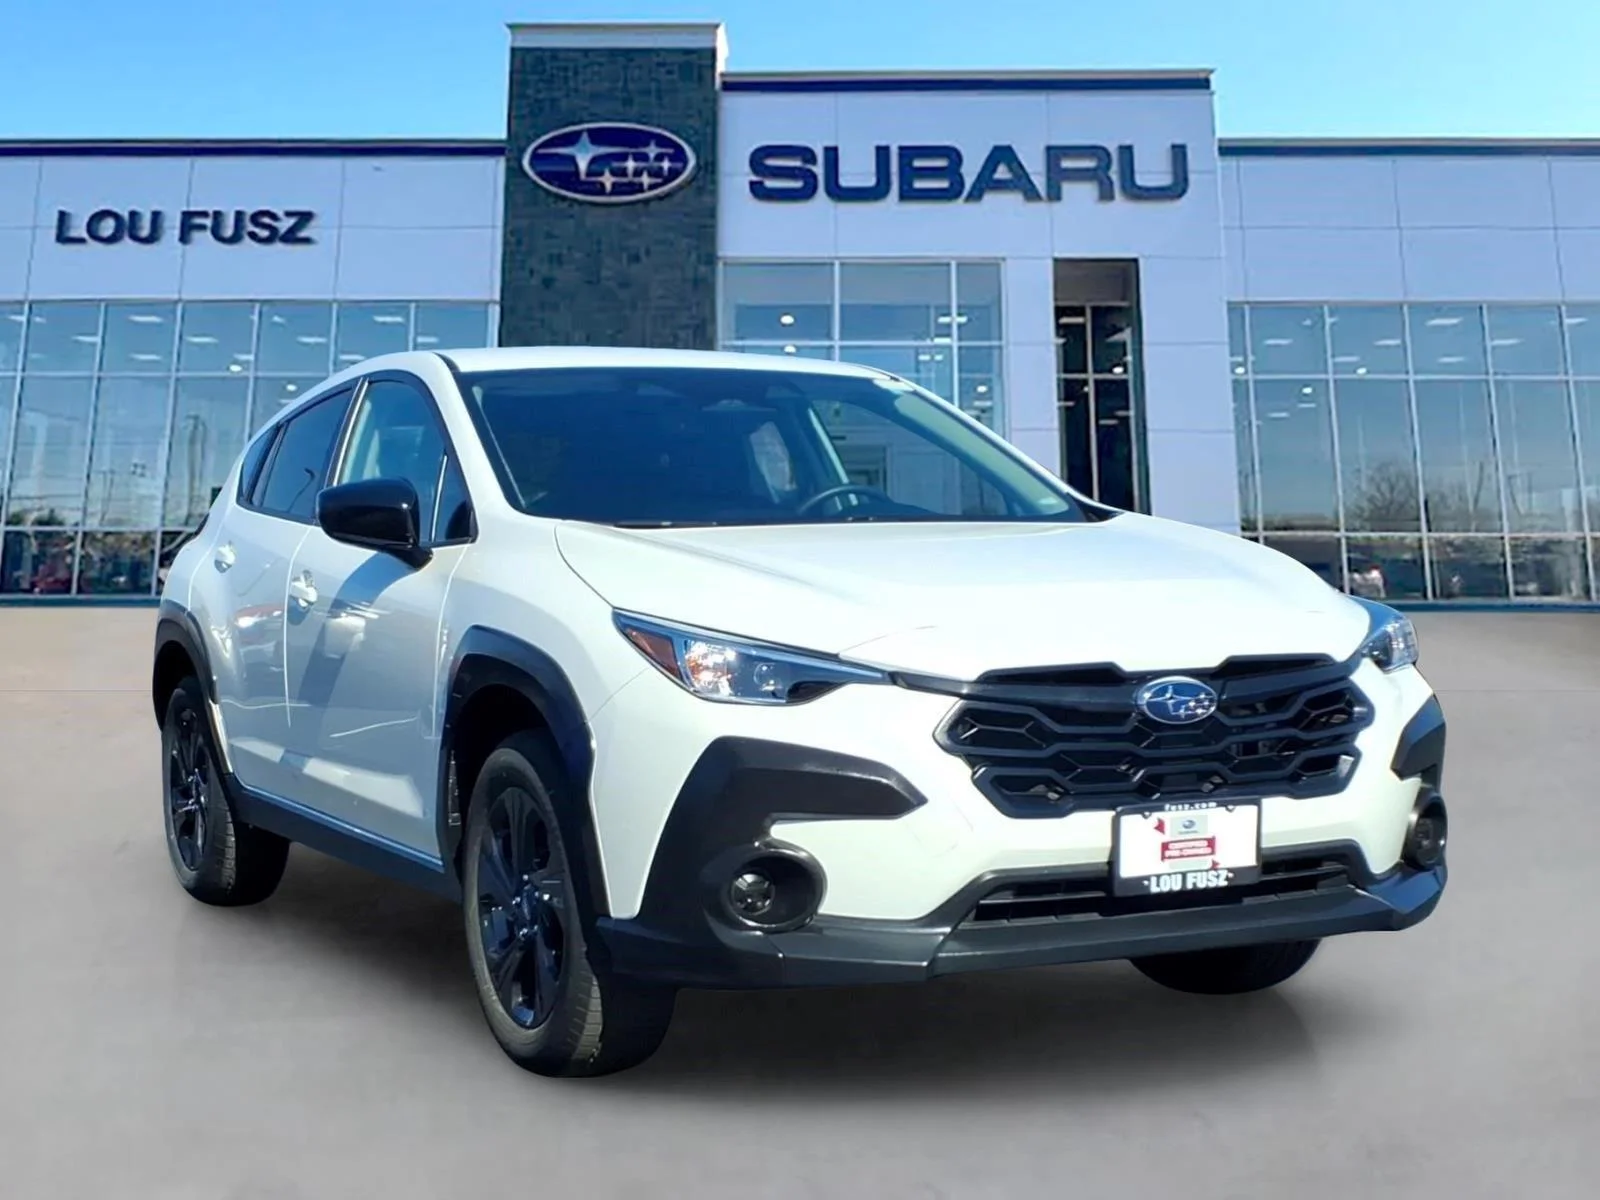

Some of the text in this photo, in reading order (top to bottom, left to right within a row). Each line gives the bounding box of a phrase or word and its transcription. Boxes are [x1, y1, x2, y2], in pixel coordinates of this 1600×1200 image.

[748, 143, 1189, 202] SUBARU
[55, 209, 316, 245] LOU FUSZ
[1150, 870, 1228, 892] LOU FUSZ
